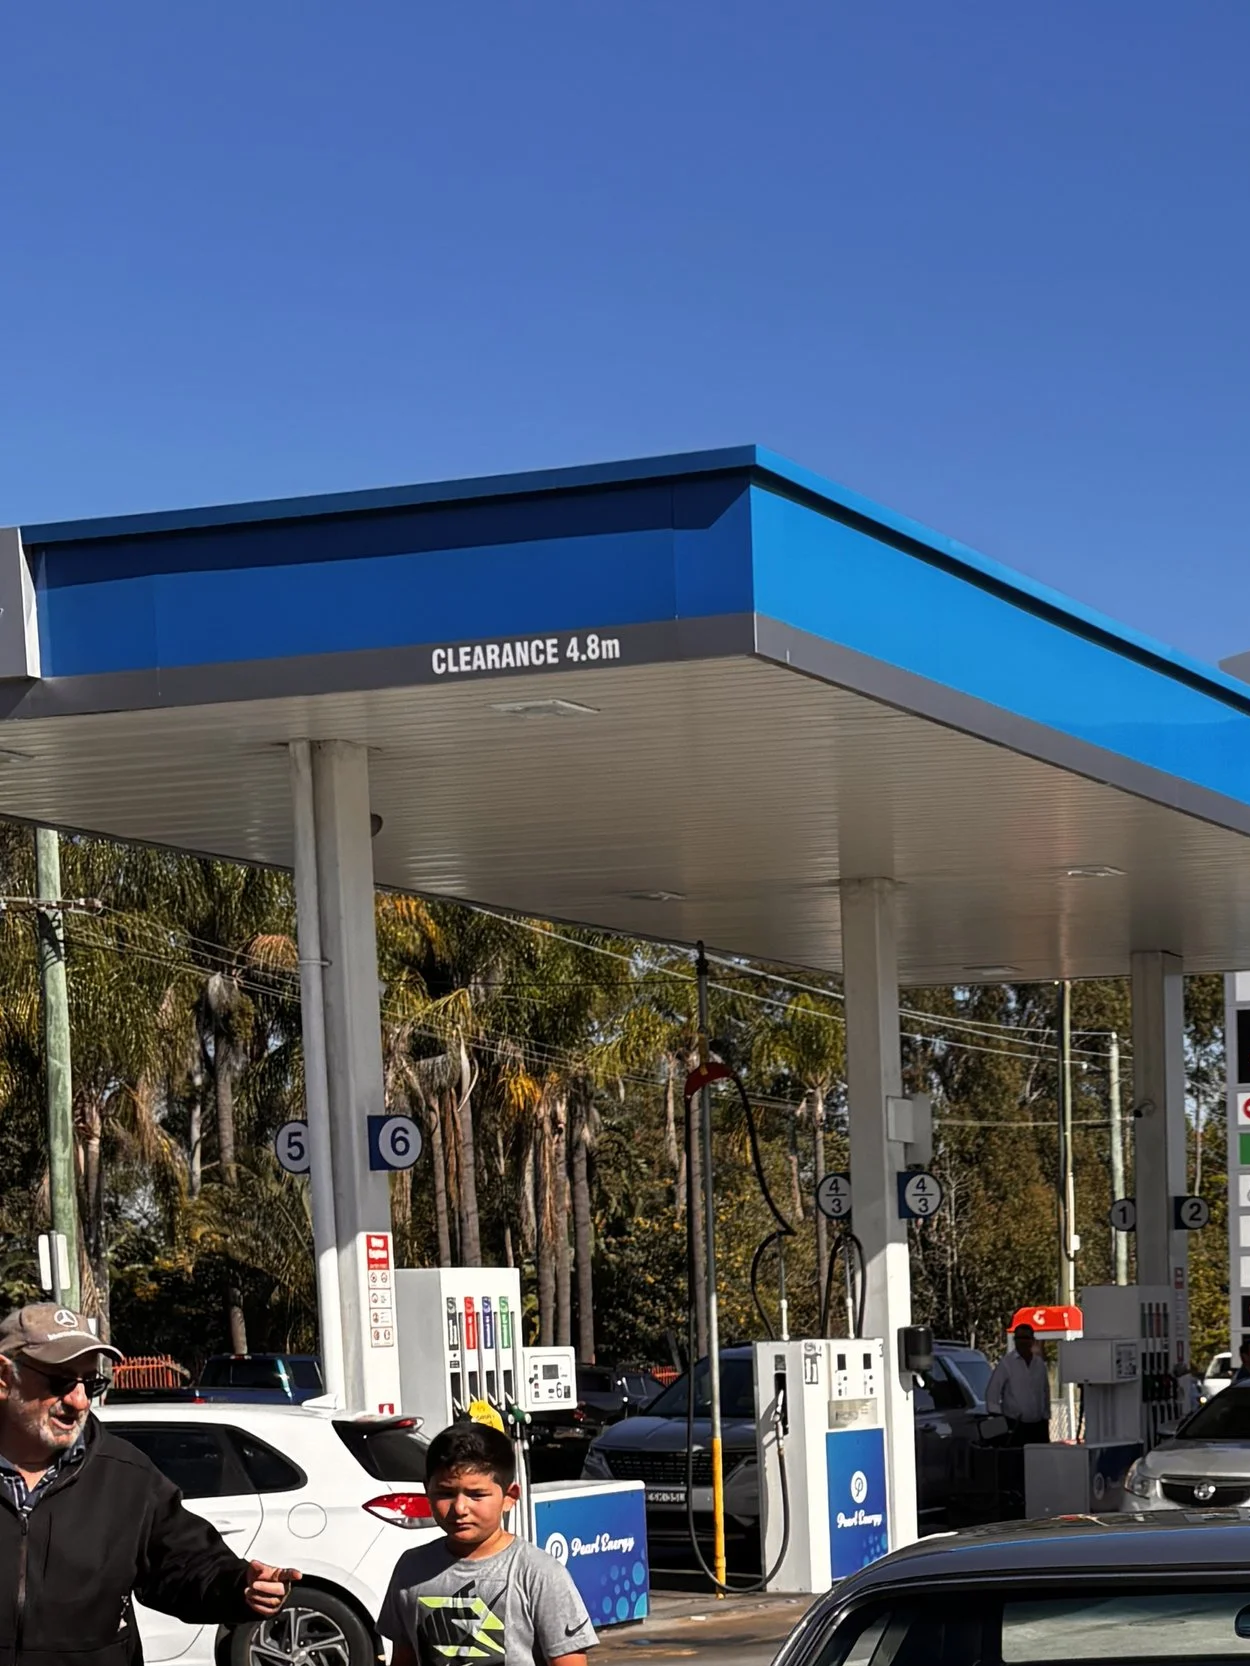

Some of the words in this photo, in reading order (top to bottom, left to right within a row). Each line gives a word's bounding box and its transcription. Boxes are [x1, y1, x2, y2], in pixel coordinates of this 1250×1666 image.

[431, 638, 559, 674] CLEARANCE
[566, 634, 621, 662] 4.8m
[287, 1131, 305, 1161] 5
[390, 1126, 411, 1157] 6
[829, 1178, 839, 1194] 4
[915, 1176, 927, 1193] 4
[831, 1197, 842, 1214] 3
[918, 1197, 929, 1213] 3
[1188, 1202, 1202, 1222] 2
[1118, 1206, 1127, 1225] 1
[570, 1534, 600, 1558] Pearl
[600, 1532, 635, 1554] Energy
